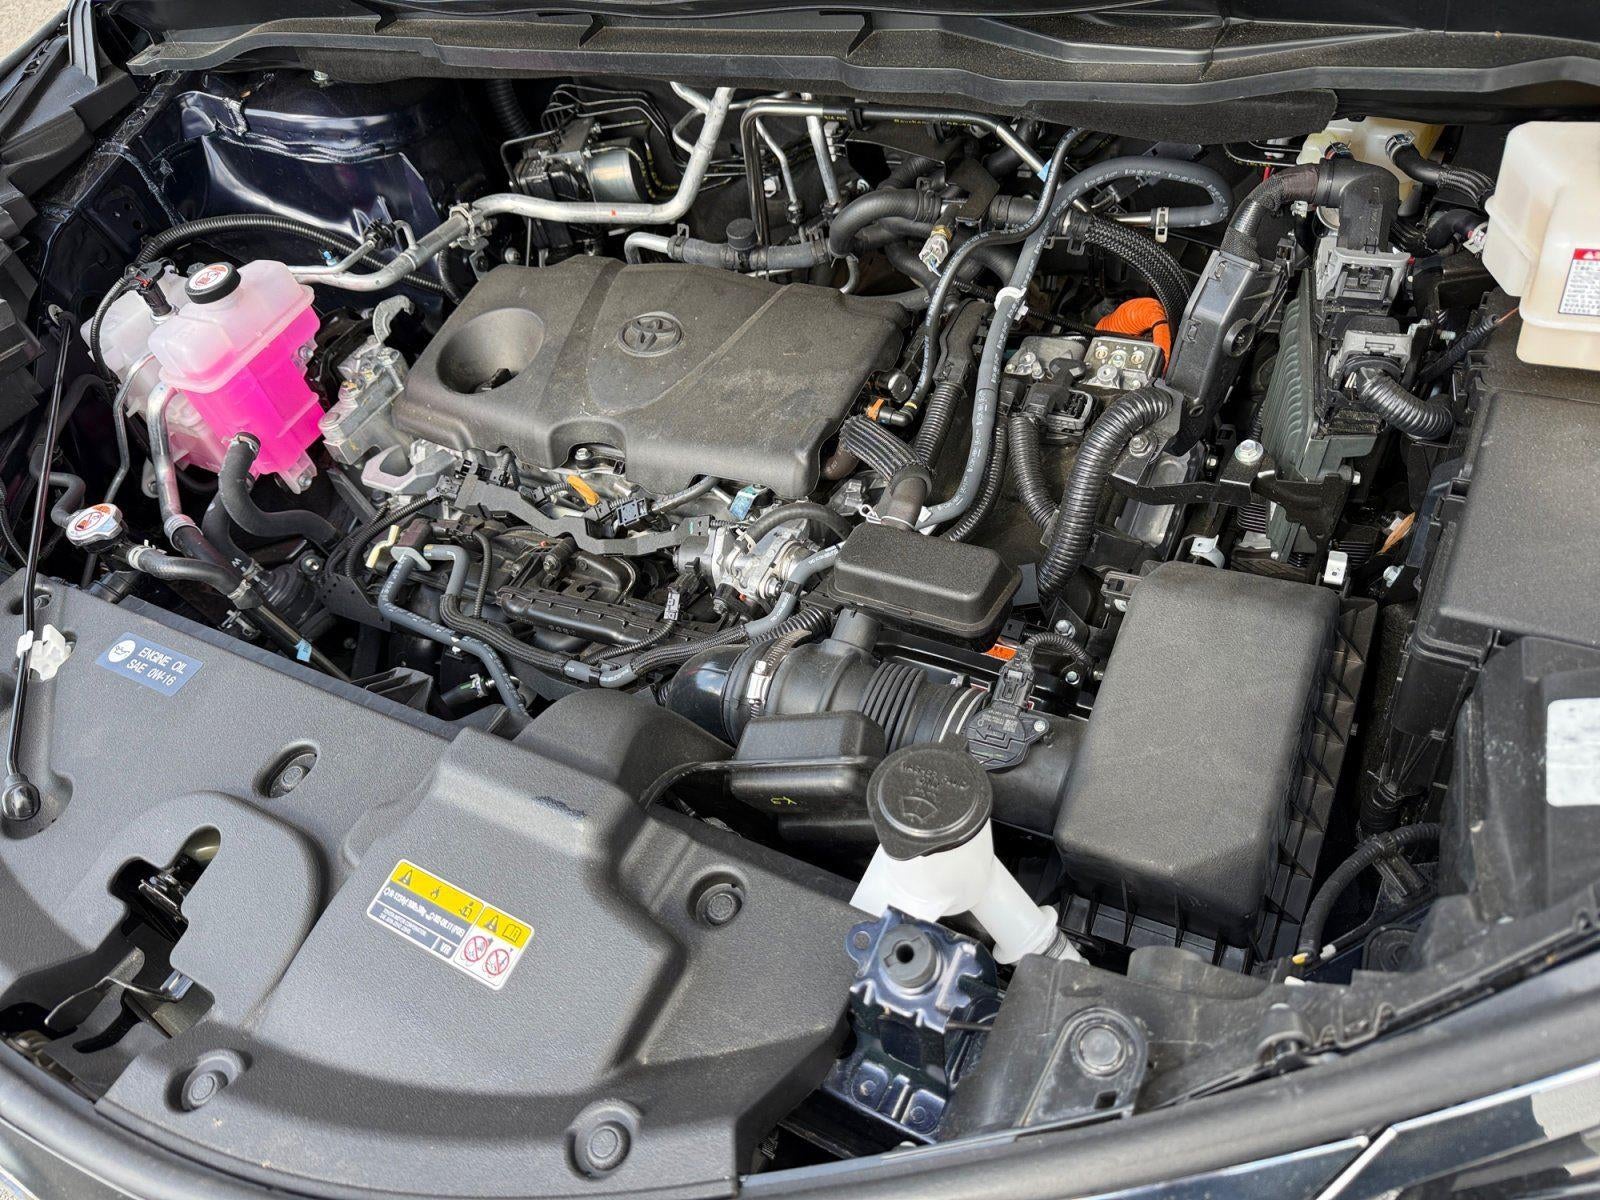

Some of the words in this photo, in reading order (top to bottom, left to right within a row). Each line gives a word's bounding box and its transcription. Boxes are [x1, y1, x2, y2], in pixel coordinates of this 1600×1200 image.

[126, 659, 149, 674] SAE
[147, 668, 177, 686] 0W-16
[138, 646, 172, 667] ENGINE
[171, 661, 188, 674] OIL
